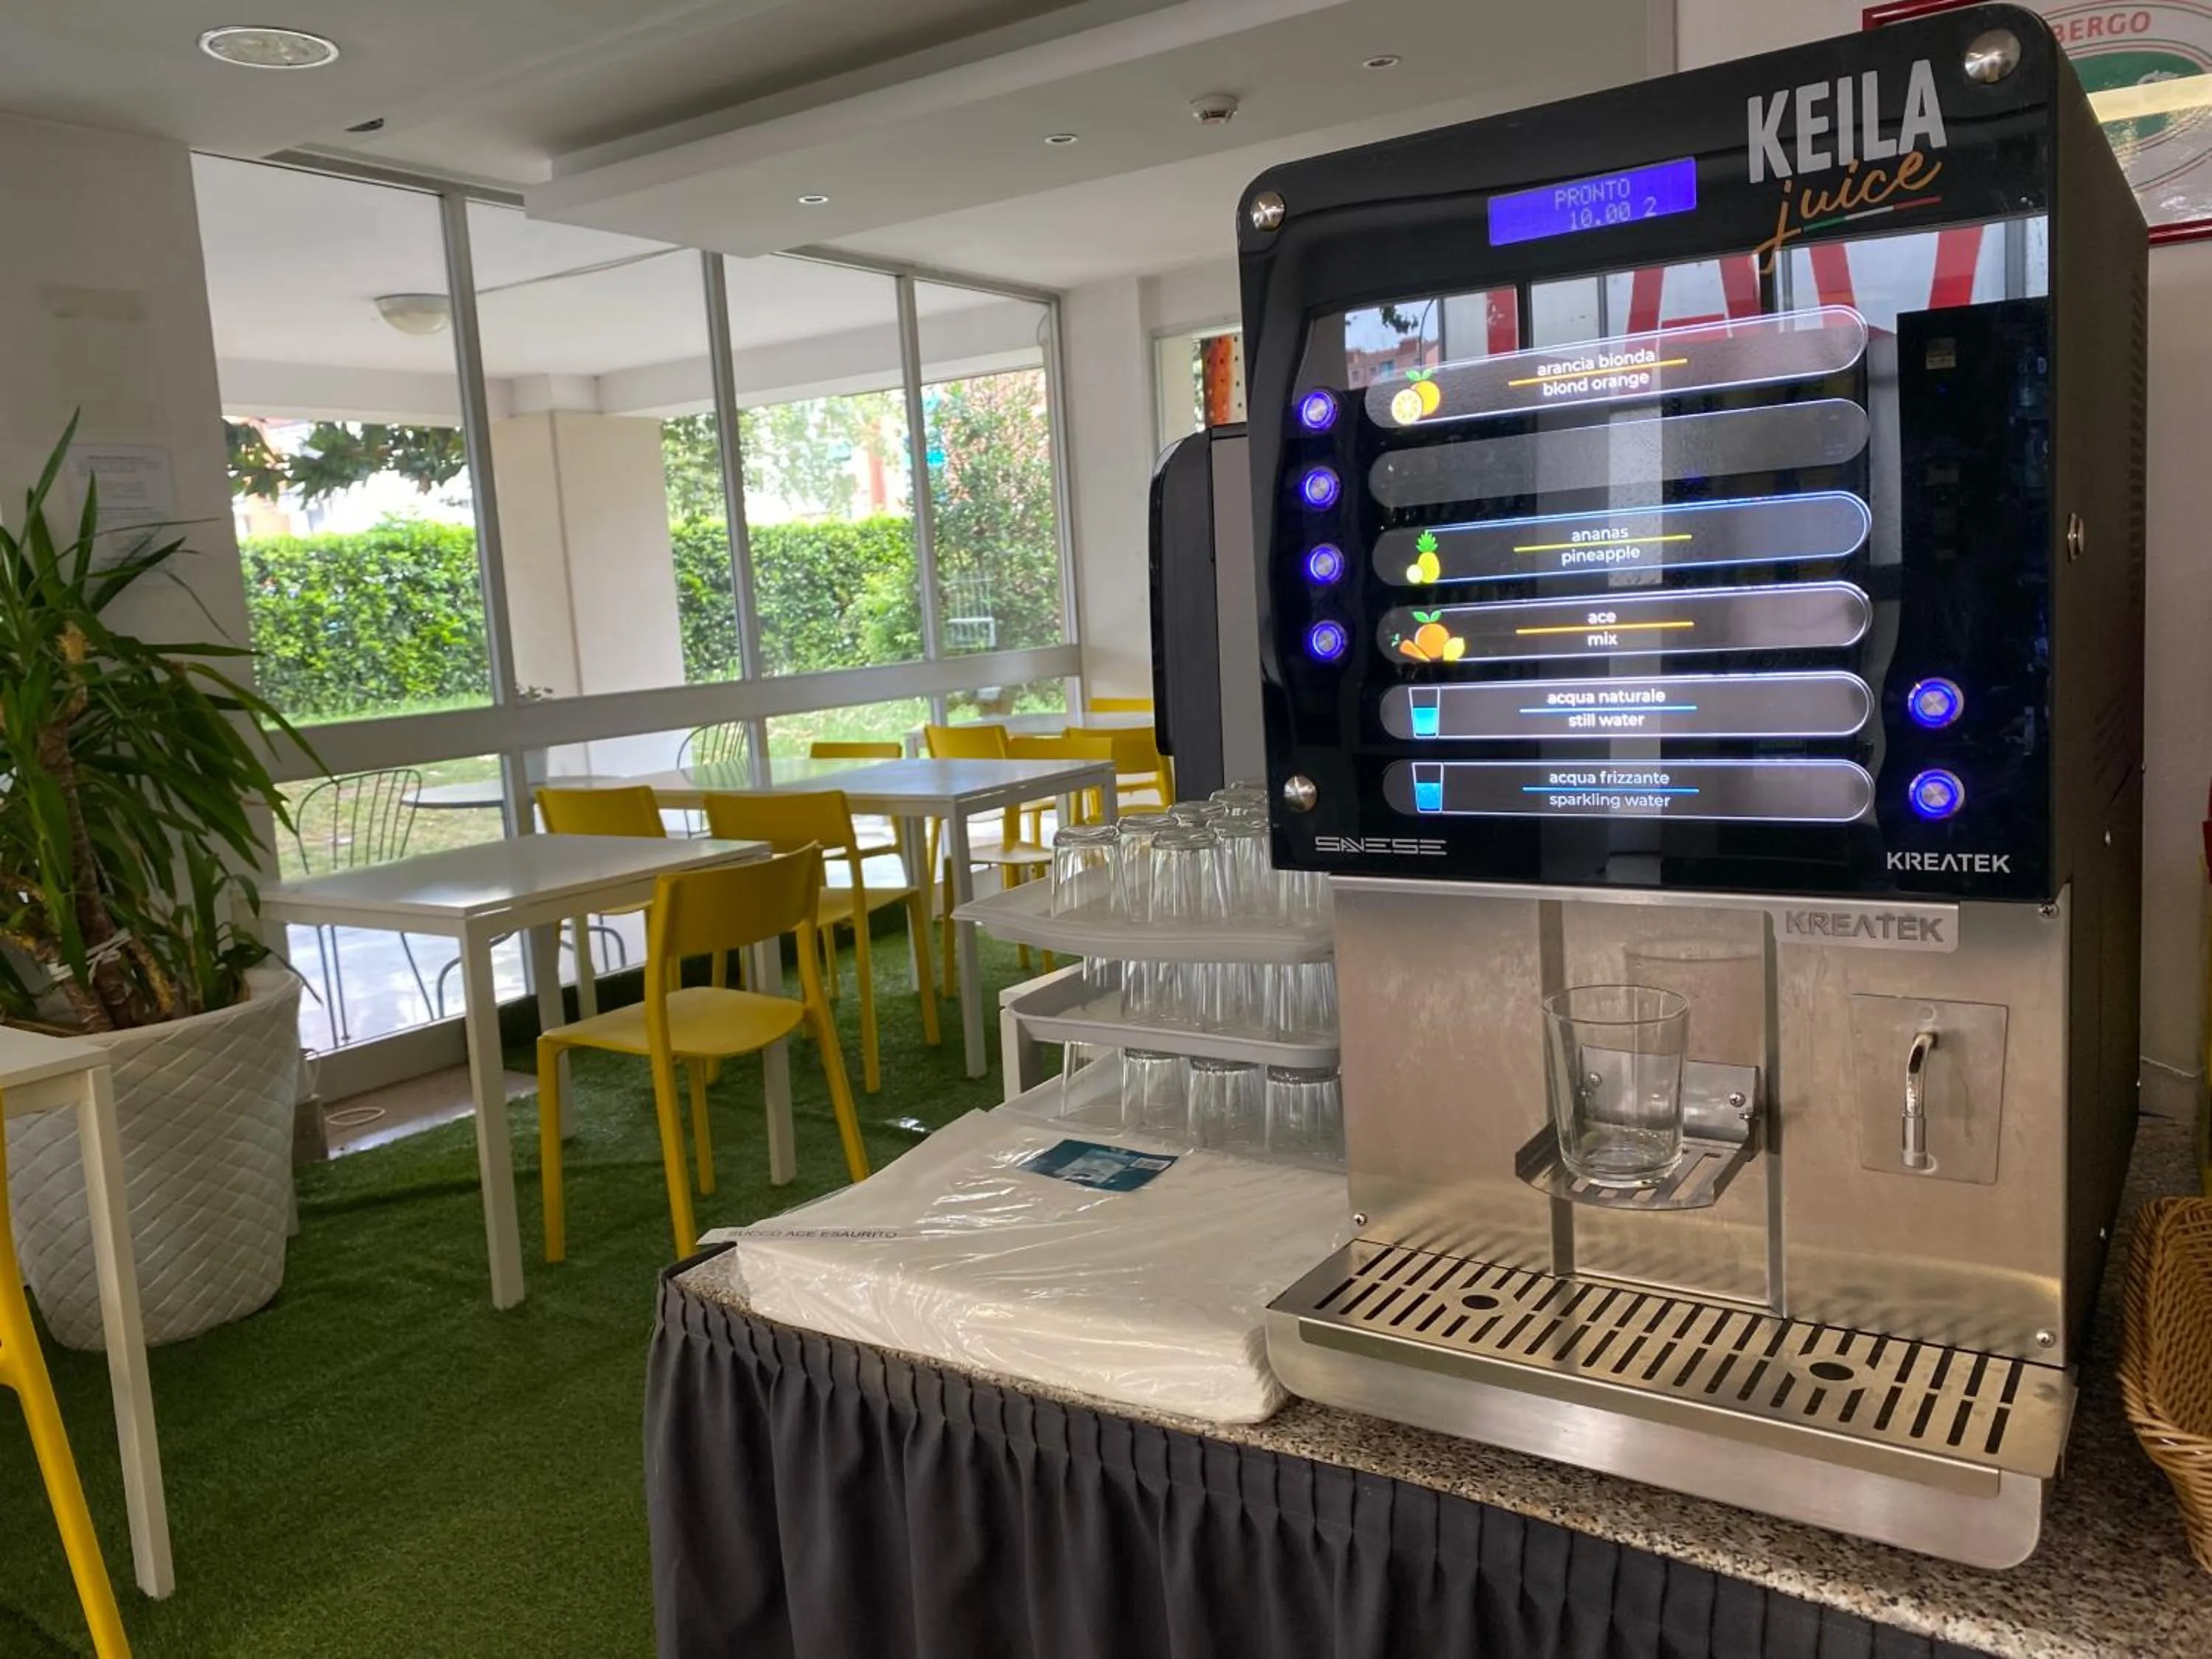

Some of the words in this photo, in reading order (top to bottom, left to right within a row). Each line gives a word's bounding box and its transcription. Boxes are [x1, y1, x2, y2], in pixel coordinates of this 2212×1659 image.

[1747, 59, 1947, 183] KEILA
[1554, 178, 1631, 211] PRONTO
[1753, 150, 1943, 274] juice
[1537, 357, 1595, 376] arancia
[1543, 377, 1588, 397] blond
[1592, 372, 1649, 389] orange
[1571, 526, 1629, 542] ananas
[1561, 546, 1641, 566] pineapple
[1587, 611, 1617, 624] ace
[1587, 631, 1618, 646] mix
[1547, 692, 1595, 706] acqua
[1599, 689, 1666, 703] naturale
[1568, 713, 1596, 727] still
[1599, 713, 1644, 726] water
[1549, 772, 1596, 786] acqua
[1599, 771, 1670, 785] frizzante
[1549, 793, 1621, 808] sparkling
[1624, 794, 1671, 807] water
[1887, 852, 2011, 874] KREATEK
[1784, 910, 1945, 942] KREATEK
